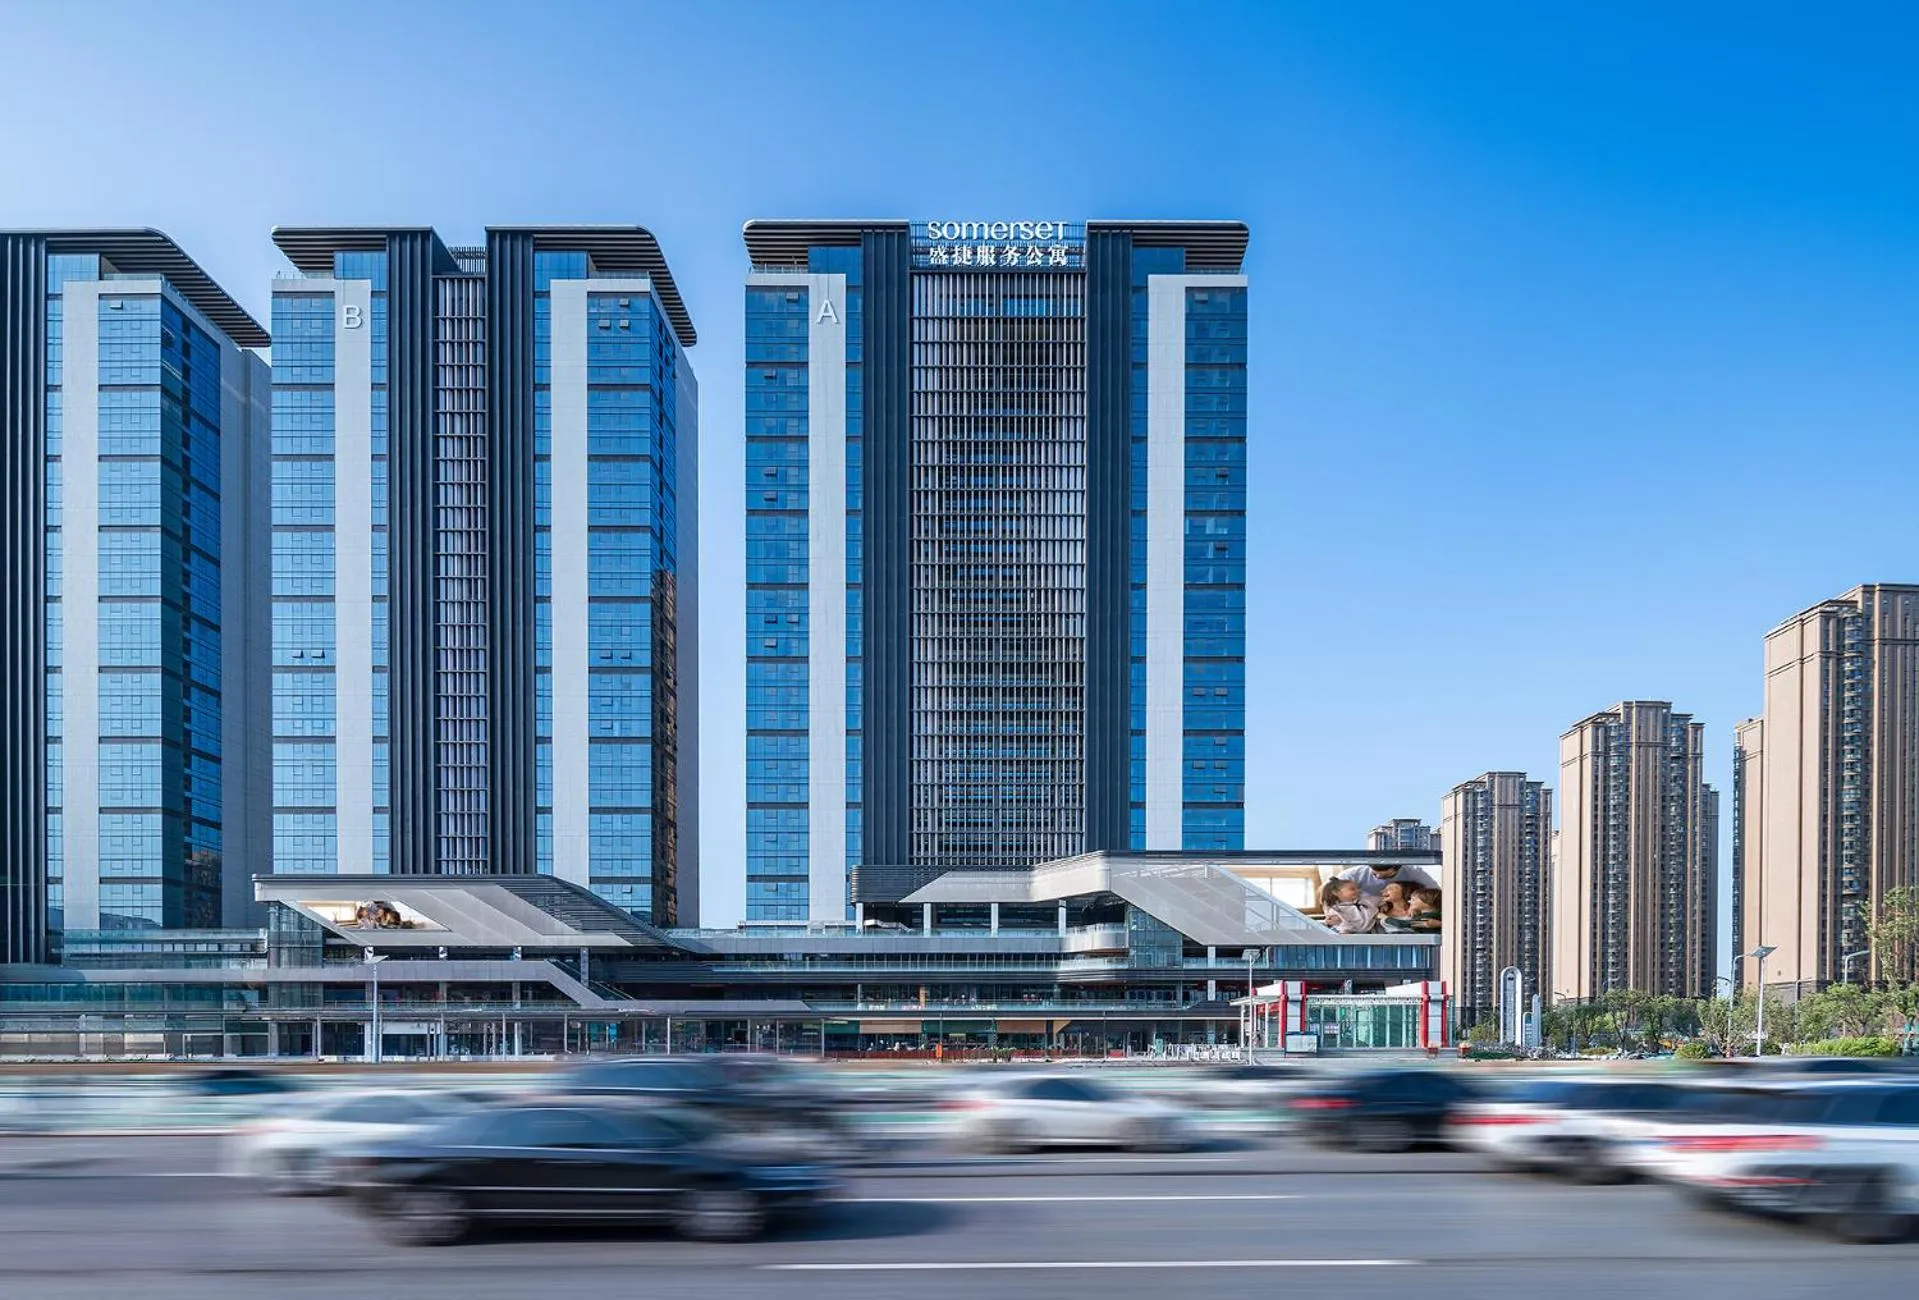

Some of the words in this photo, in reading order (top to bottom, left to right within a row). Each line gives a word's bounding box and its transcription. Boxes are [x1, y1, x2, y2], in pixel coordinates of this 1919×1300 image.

[929, 244, 1069, 266] 盛捷服务公寓
[343, 305, 363, 329] B
[815, 299, 840, 324] A
